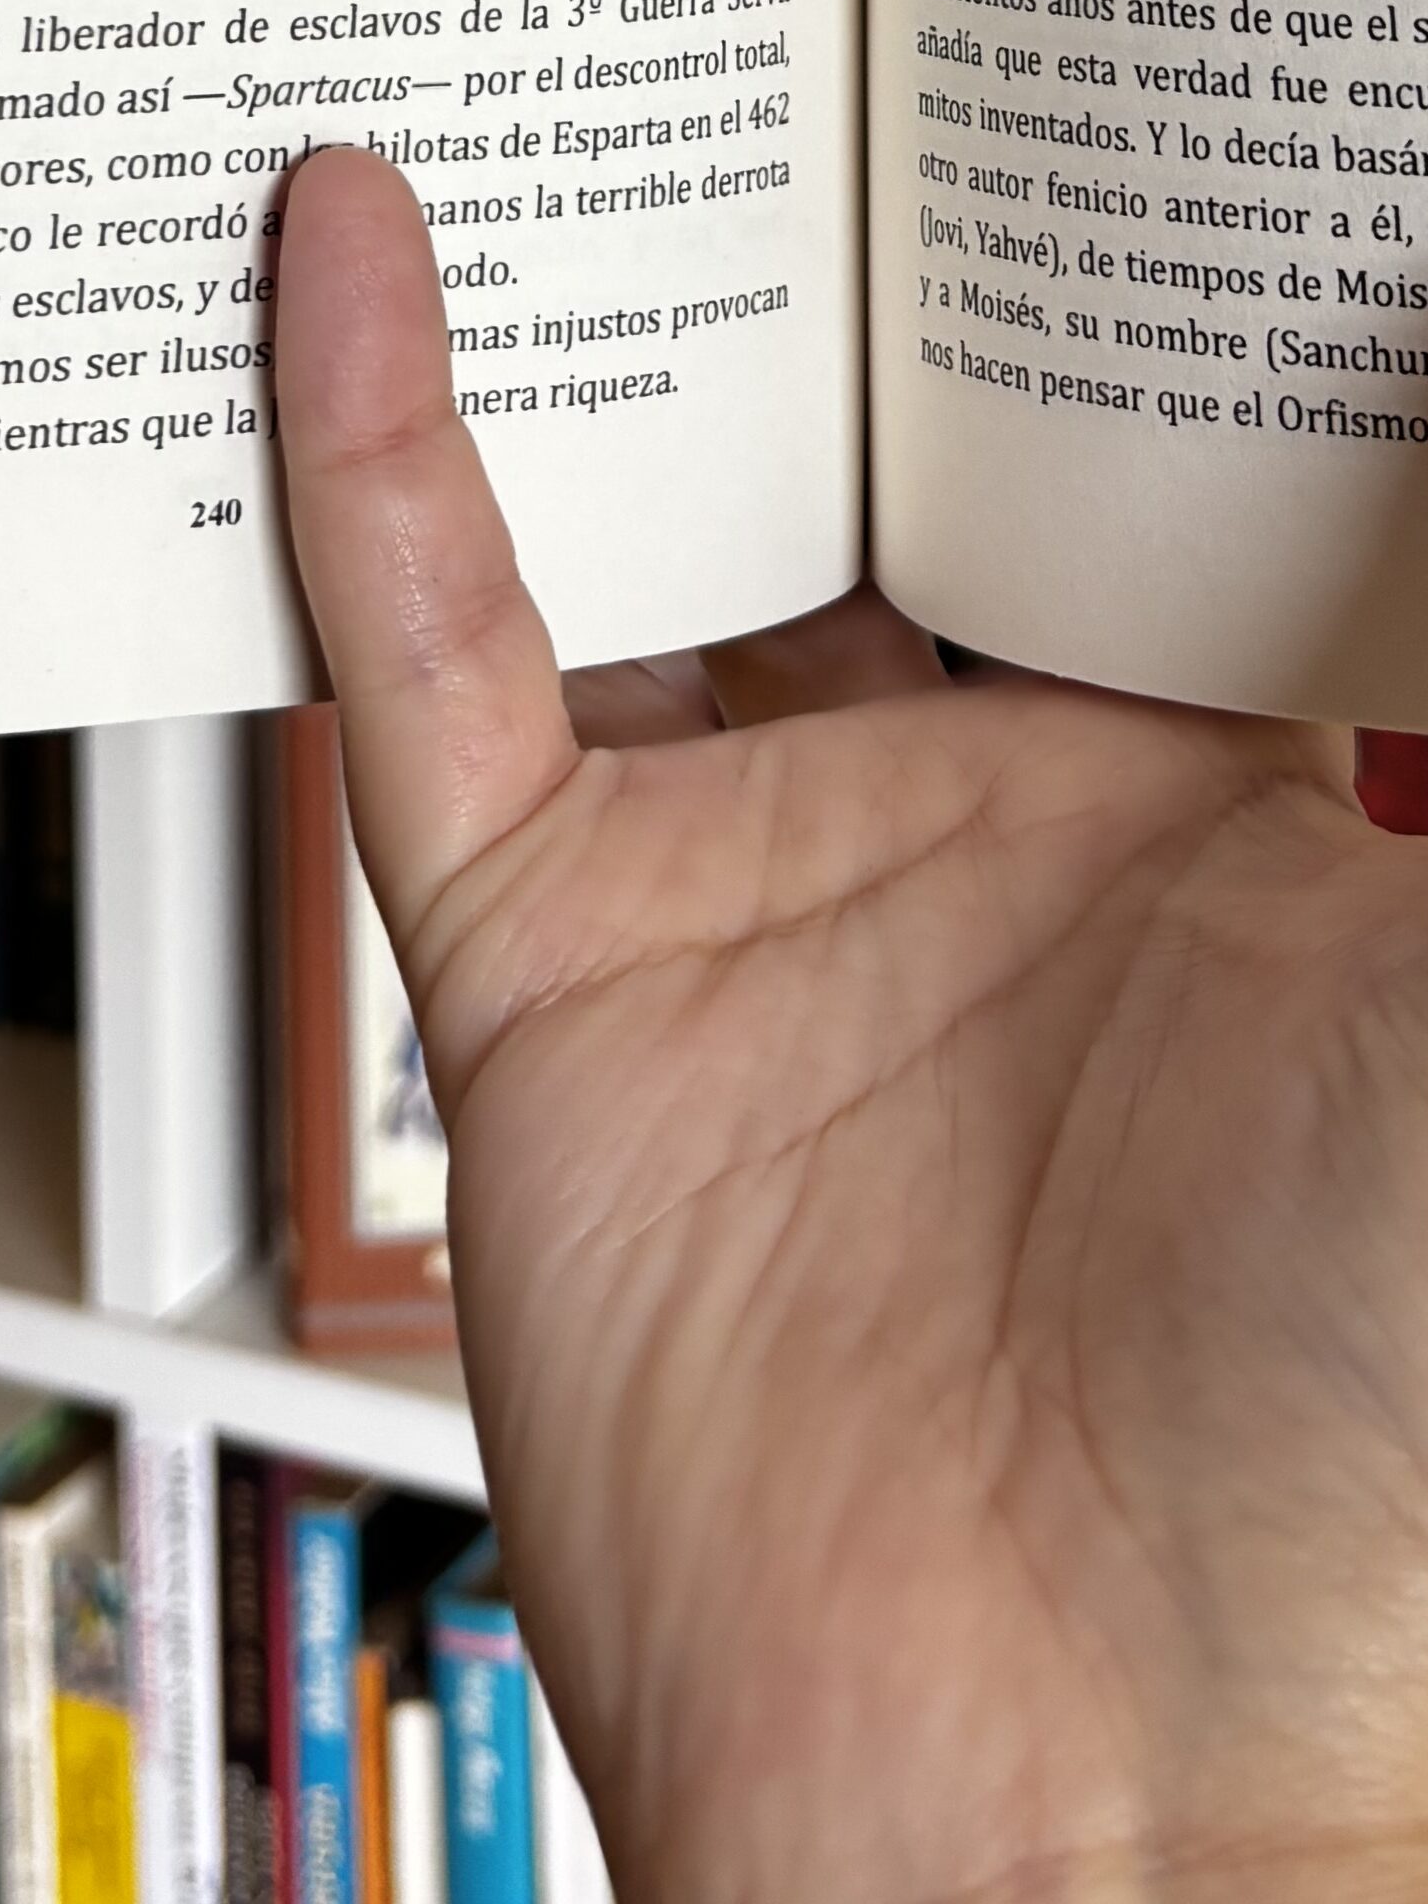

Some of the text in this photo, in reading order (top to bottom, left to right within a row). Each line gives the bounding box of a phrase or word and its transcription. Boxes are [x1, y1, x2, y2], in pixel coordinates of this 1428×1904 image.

[916, 24, 984, 68] añadía
[994, 46, 1043, 82] que
[1057, 53, 1118, 87] esta
[1133, 58, 1253, 100] verdad
[1270, 64, 1329, 105] fue
[189, 498, 243, 529] 240
